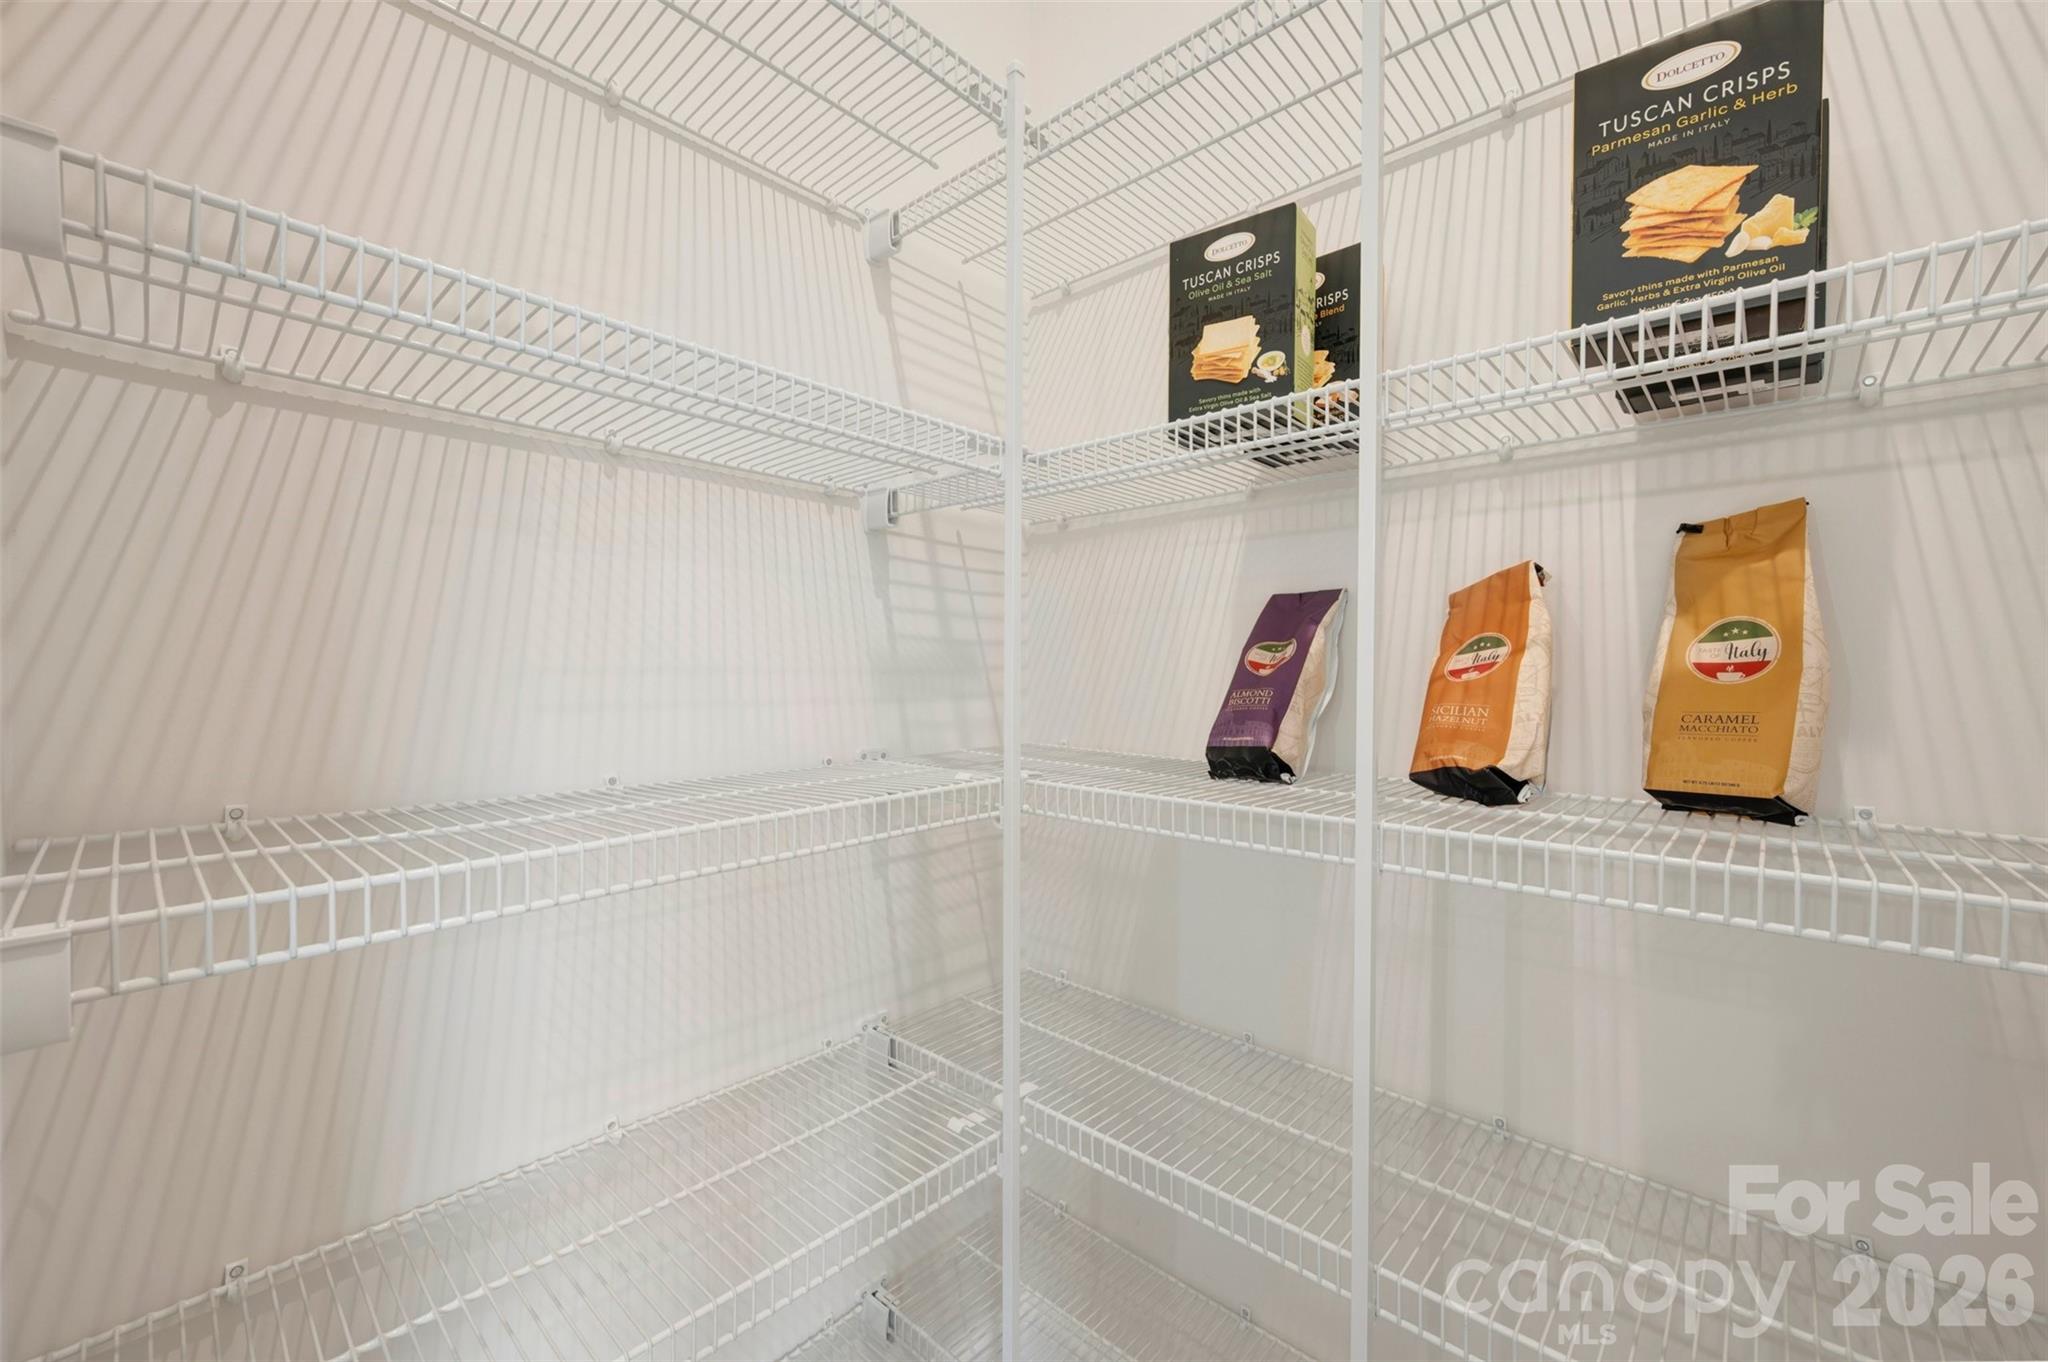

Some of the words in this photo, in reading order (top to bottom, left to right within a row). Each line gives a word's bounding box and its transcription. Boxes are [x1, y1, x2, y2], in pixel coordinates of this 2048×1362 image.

[1655, 51, 1726, 84] DOLCETTO
[1599, 92, 1693, 138] TUSCAN
[1703, 61, 1792, 103] CRISPS
[1591, 123, 1671, 157] Parmesan
[1676, 102, 1729, 129] Garlic
[1733, 98, 1747, 111] &
[1752, 82, 1799, 105] Herb
[1647, 133, 1679, 150] MADE
[1682, 128, 1695, 139] IN
[1698, 118, 1732, 134] ITALY
[1211, 240, 1249, 256] DOLCETTO
[1182, 265, 1231, 291] TUSCAN
[1235, 251, 1281, 274] CRISPS
[1602, 287, 1637, 302] Savory
[1637, 281, 1663, 293] thins
[1665, 274, 1695, 287] made
[1697, 267, 1721, 280] with
[1722, 255, 1779, 274] Parmesan
[1188, 287, 1210, 300] Olive
[1212, 282, 1225, 293] Oil
[1226, 280, 1233, 289] &
[1235, 275, 1252, 287] Sea
[1254, 269, 1273, 281] Salt
[1630, 292, 1661, 305] Herbs
[1662, 289, 1671, 297] &
[1673, 282, 1701, 296] Extra
[1703, 275, 1735, 289] Virgin
[1737, 267, 1766, 280] Olive
[1769, 262, 1786, 273] Oil
[1208, 293, 1225, 302] MADE
[1234, 286, 1251, 295] ITALY
[1316, 288, 1350, 309] RISPS
[1320, 304, 1346, 319] Blend
[1471, 650, 1501, 664] Italy
[1724, 640, 1768, 662] Italy
[1228, 697, 1272, 706] BISCOTTI
[1230, 689, 1274, 698] ALMOND
[1428, 714, 1488, 726] HAZELNUT
[1431, 705, 1489, 718] SICILIAN
[1680, 713, 1760, 725] CARAMEL
[1679, 724, 1760, 734] MACCHIATO
